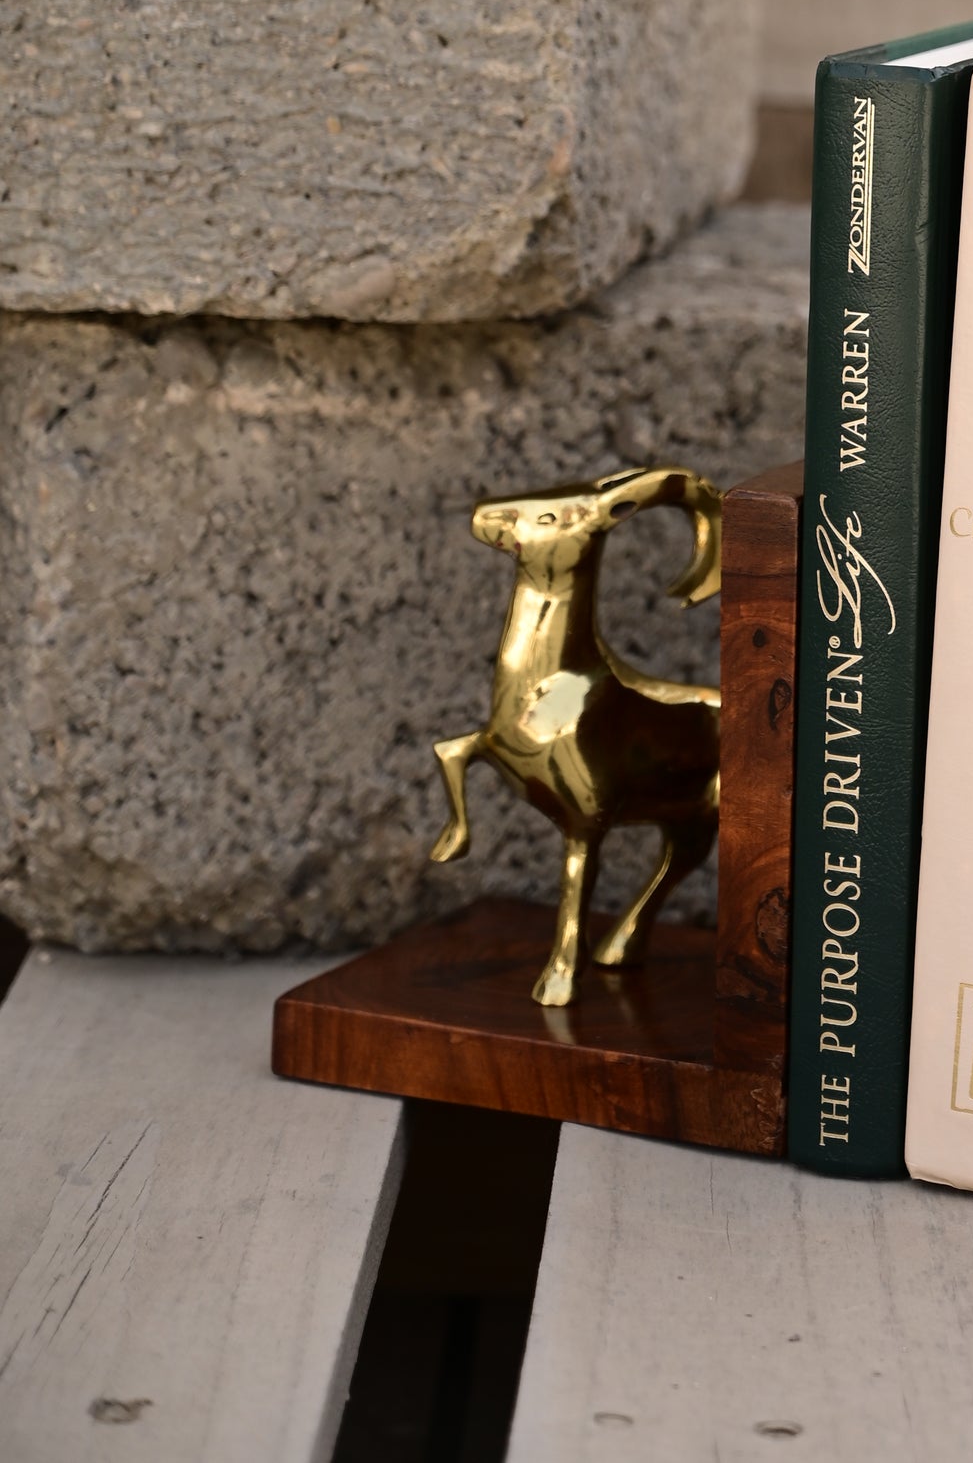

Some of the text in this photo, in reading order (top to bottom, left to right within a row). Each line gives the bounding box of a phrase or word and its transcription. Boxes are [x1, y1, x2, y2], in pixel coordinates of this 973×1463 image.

[839, 308, 871, 473] WARREN
[816, 494, 897, 649] Life
[819, 851, 862, 1058] PURPOSE
[819, 1074, 851, 1147] THE
